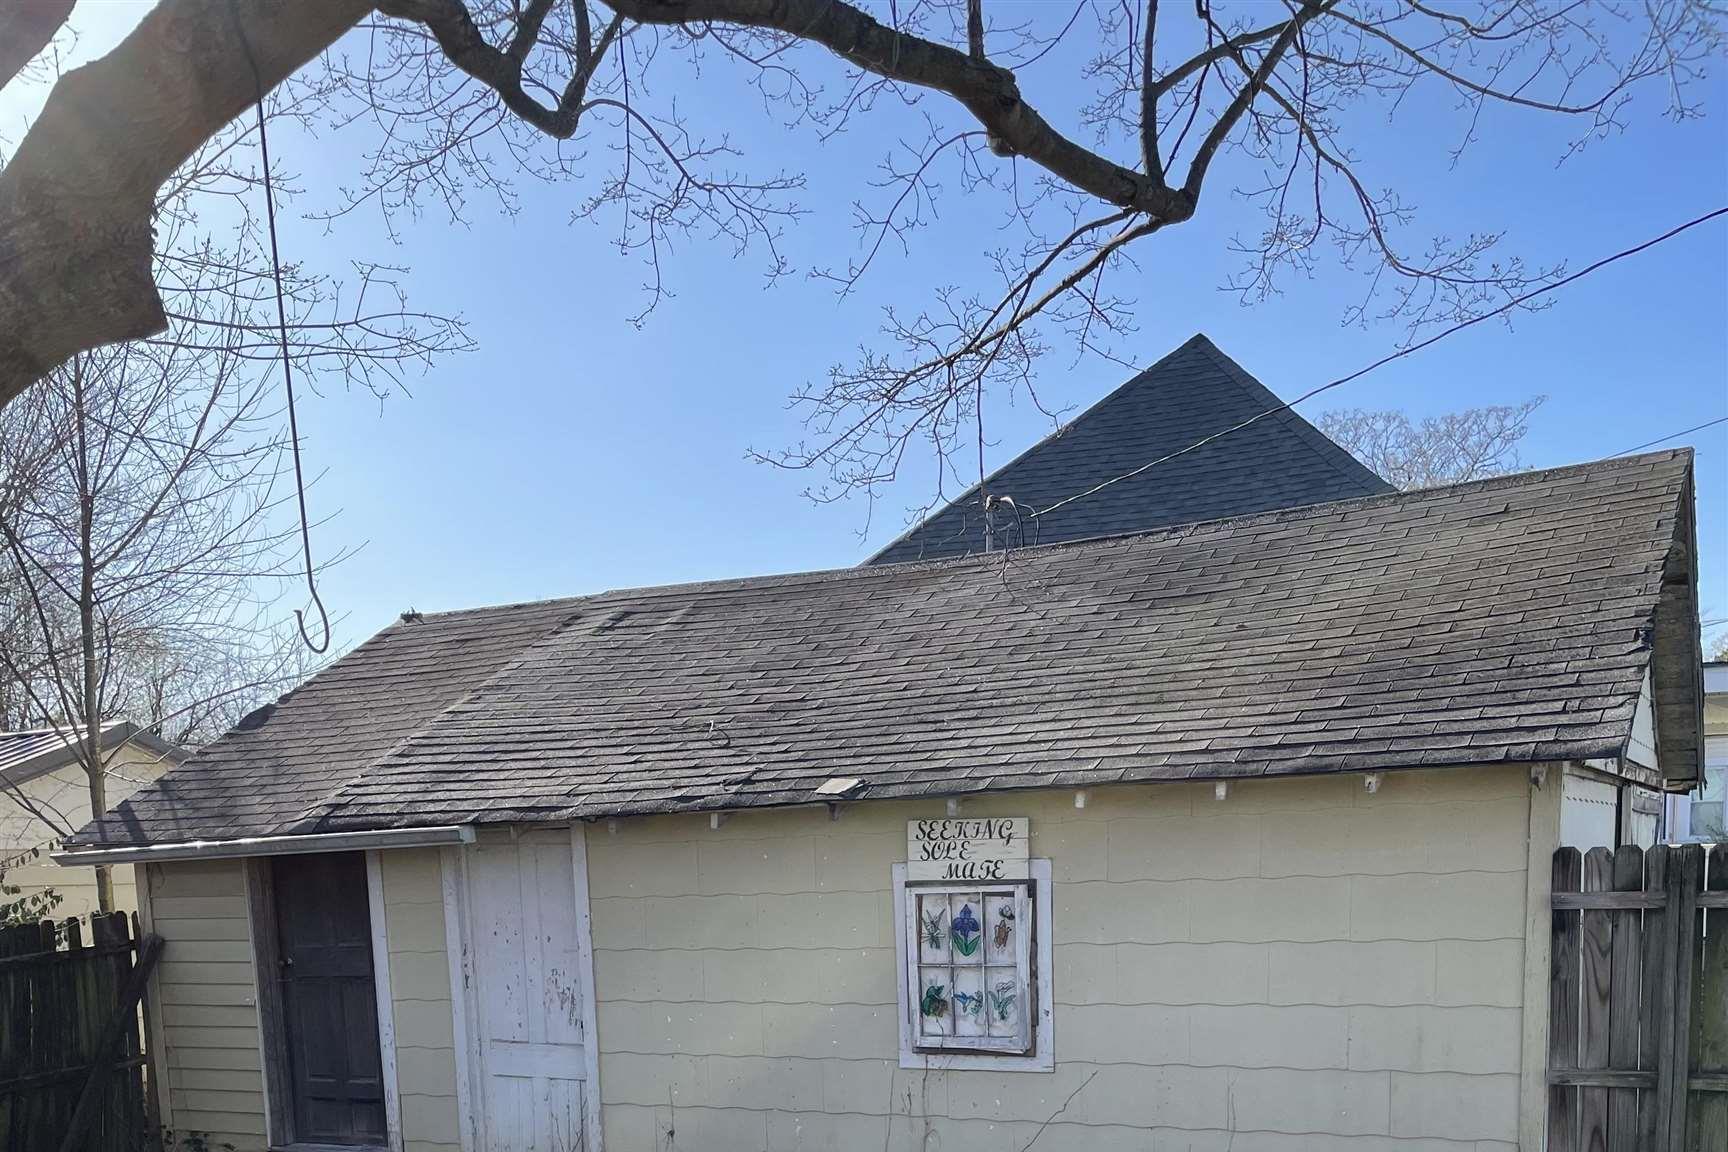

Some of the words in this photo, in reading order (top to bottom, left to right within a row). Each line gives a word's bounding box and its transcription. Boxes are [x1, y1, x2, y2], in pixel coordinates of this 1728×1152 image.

[915, 819, 1014, 846] SEEKING
[920, 840, 972, 861] SOLE
[942, 860, 1006, 880] MATE
